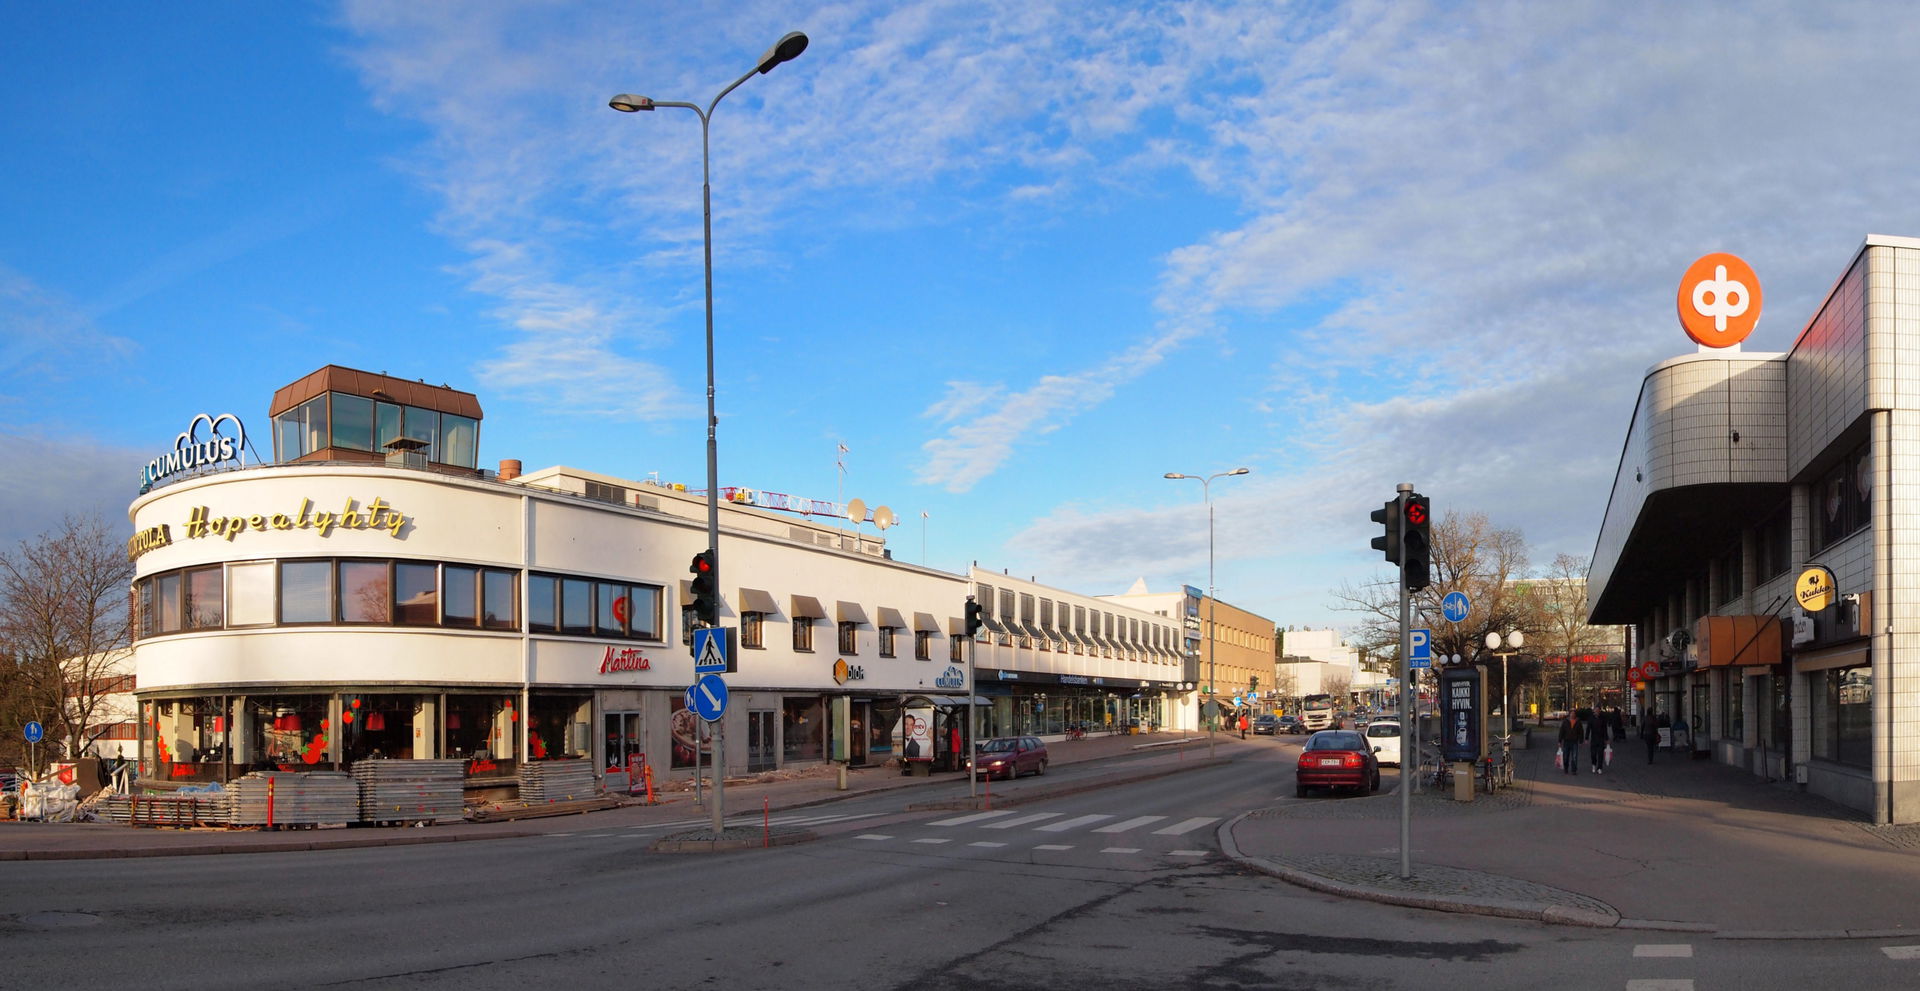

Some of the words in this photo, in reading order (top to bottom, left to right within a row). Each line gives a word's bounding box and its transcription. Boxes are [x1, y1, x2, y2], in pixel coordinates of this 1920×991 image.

[148, 437, 235, 482] CUMULUS
[183, 496, 406, 541] Hopealyhty
[1801, 585, 1832, 600] Kukko
[1410, 631, 1427, 657] P
[600, 645, 651, 674] Martina
